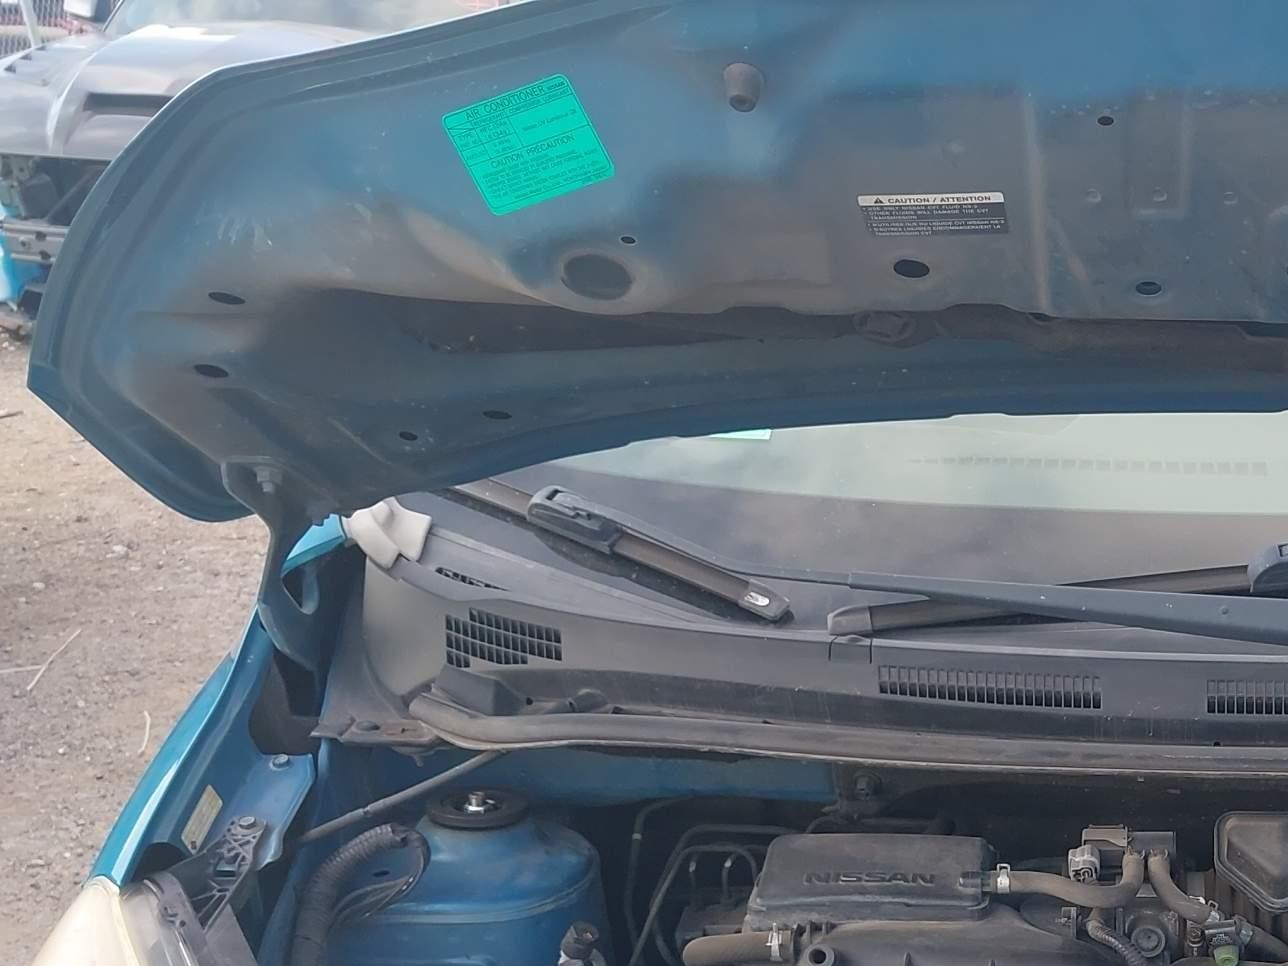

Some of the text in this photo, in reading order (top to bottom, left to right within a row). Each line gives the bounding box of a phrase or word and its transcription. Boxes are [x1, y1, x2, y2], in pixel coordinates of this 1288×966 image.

[464, 85, 545, 121] AIR CONDITIONER
[490, 150, 524, 168] CAUTION
[526, 134, 576, 155] PRECAUTION
[887, 197, 930, 205] CAUTION
[940, 195, 991, 203] ATTENTION
[803, 872, 935, 886] NISSAN
